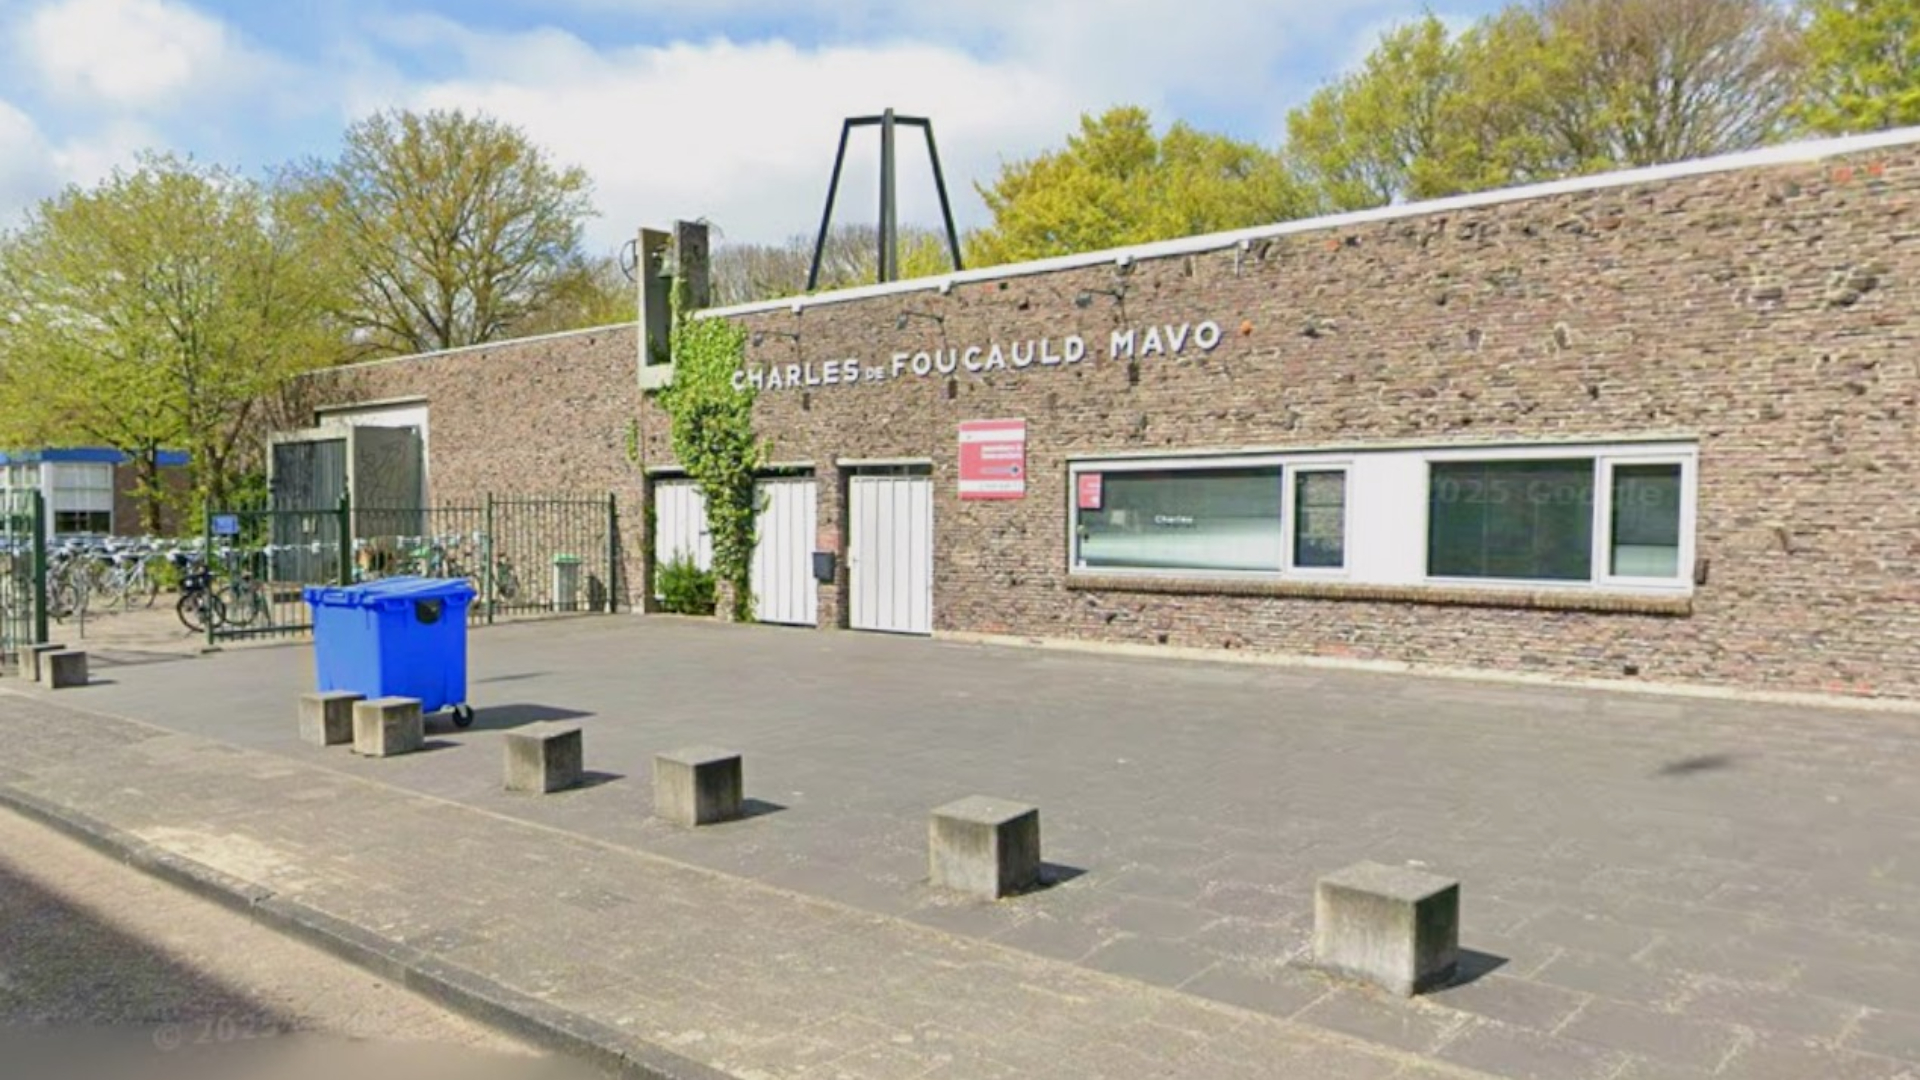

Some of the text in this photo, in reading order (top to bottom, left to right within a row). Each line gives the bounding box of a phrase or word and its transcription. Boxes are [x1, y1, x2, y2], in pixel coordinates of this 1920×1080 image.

[730, 321, 1222, 391] CHARLES DE FOUCAULD MAVO
